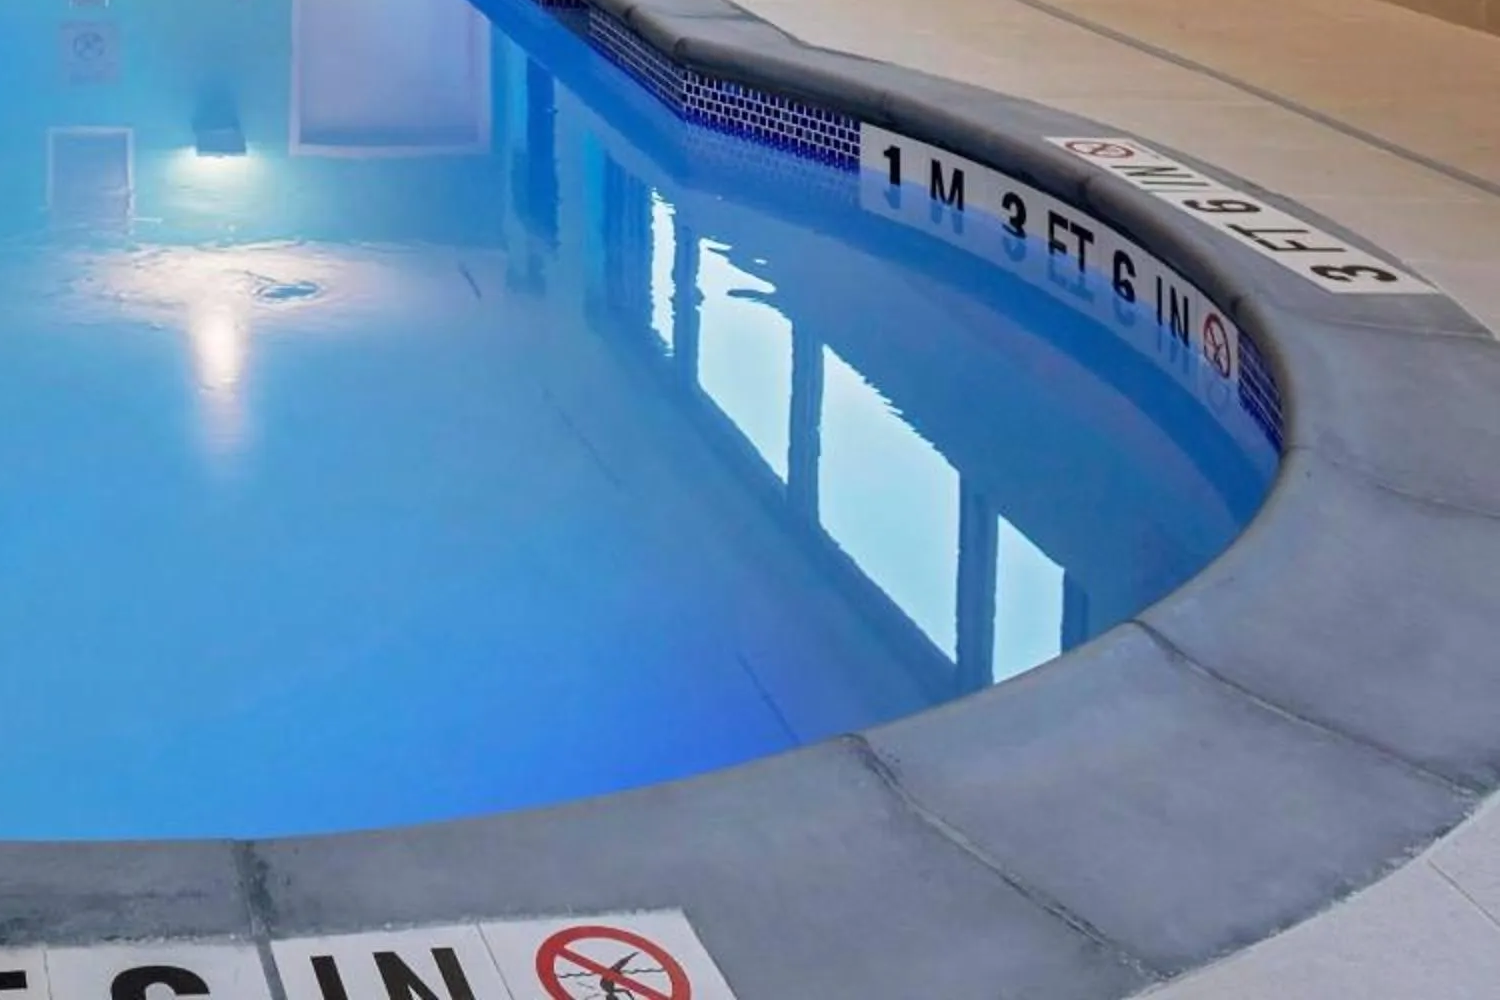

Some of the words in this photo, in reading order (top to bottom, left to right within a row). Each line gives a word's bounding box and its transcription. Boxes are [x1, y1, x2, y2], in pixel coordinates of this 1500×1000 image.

[1110, 165, 1211, 187] IN
[883, 145, 900, 186] 1
[930, 159, 965, 212] M
[1001, 192, 1027, 239] 3
[1048, 210, 1094, 273] FT
[1112, 250, 1136, 303] 6
[1156, 275, 1189, 348] IN
[1227, 224, 1347, 253] FT
[1310, 264, 1398, 283] 3
